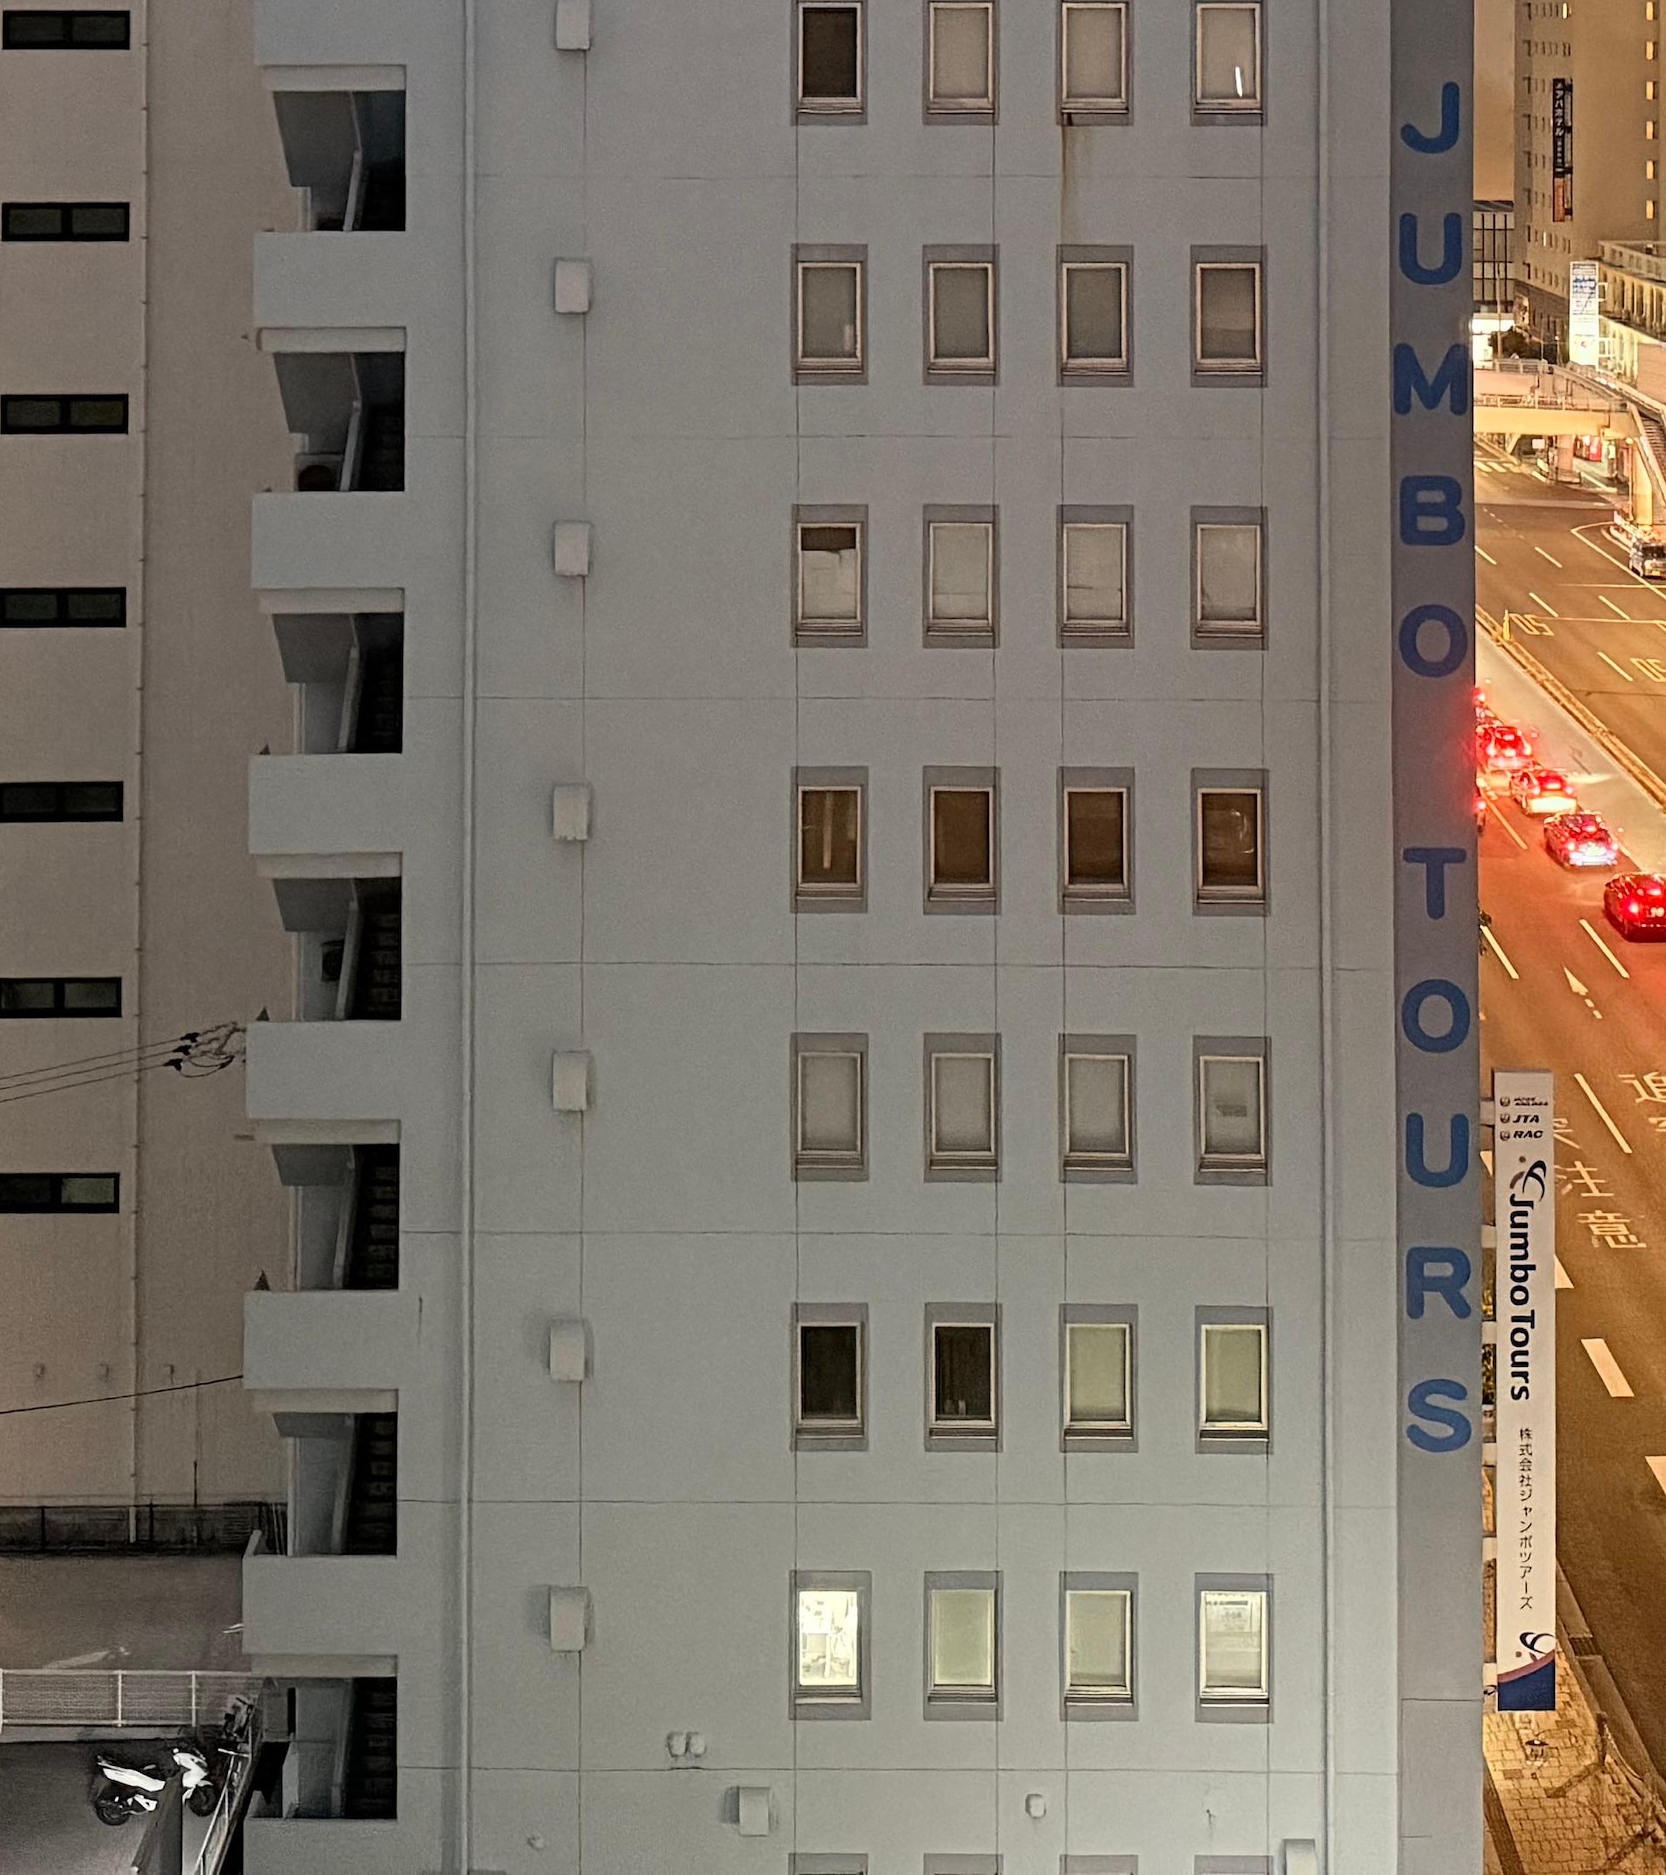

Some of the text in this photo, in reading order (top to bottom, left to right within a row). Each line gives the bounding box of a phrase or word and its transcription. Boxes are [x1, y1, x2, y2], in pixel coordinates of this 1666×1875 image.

[1393, 81, 1472, 1453] JUMBO TOURS
[1512, 1114, 1540, 1123] JTA
[1513, 1130, 1544, 1139] RAC
[1509, 1193, 1537, 1401] Jumbo Tours
